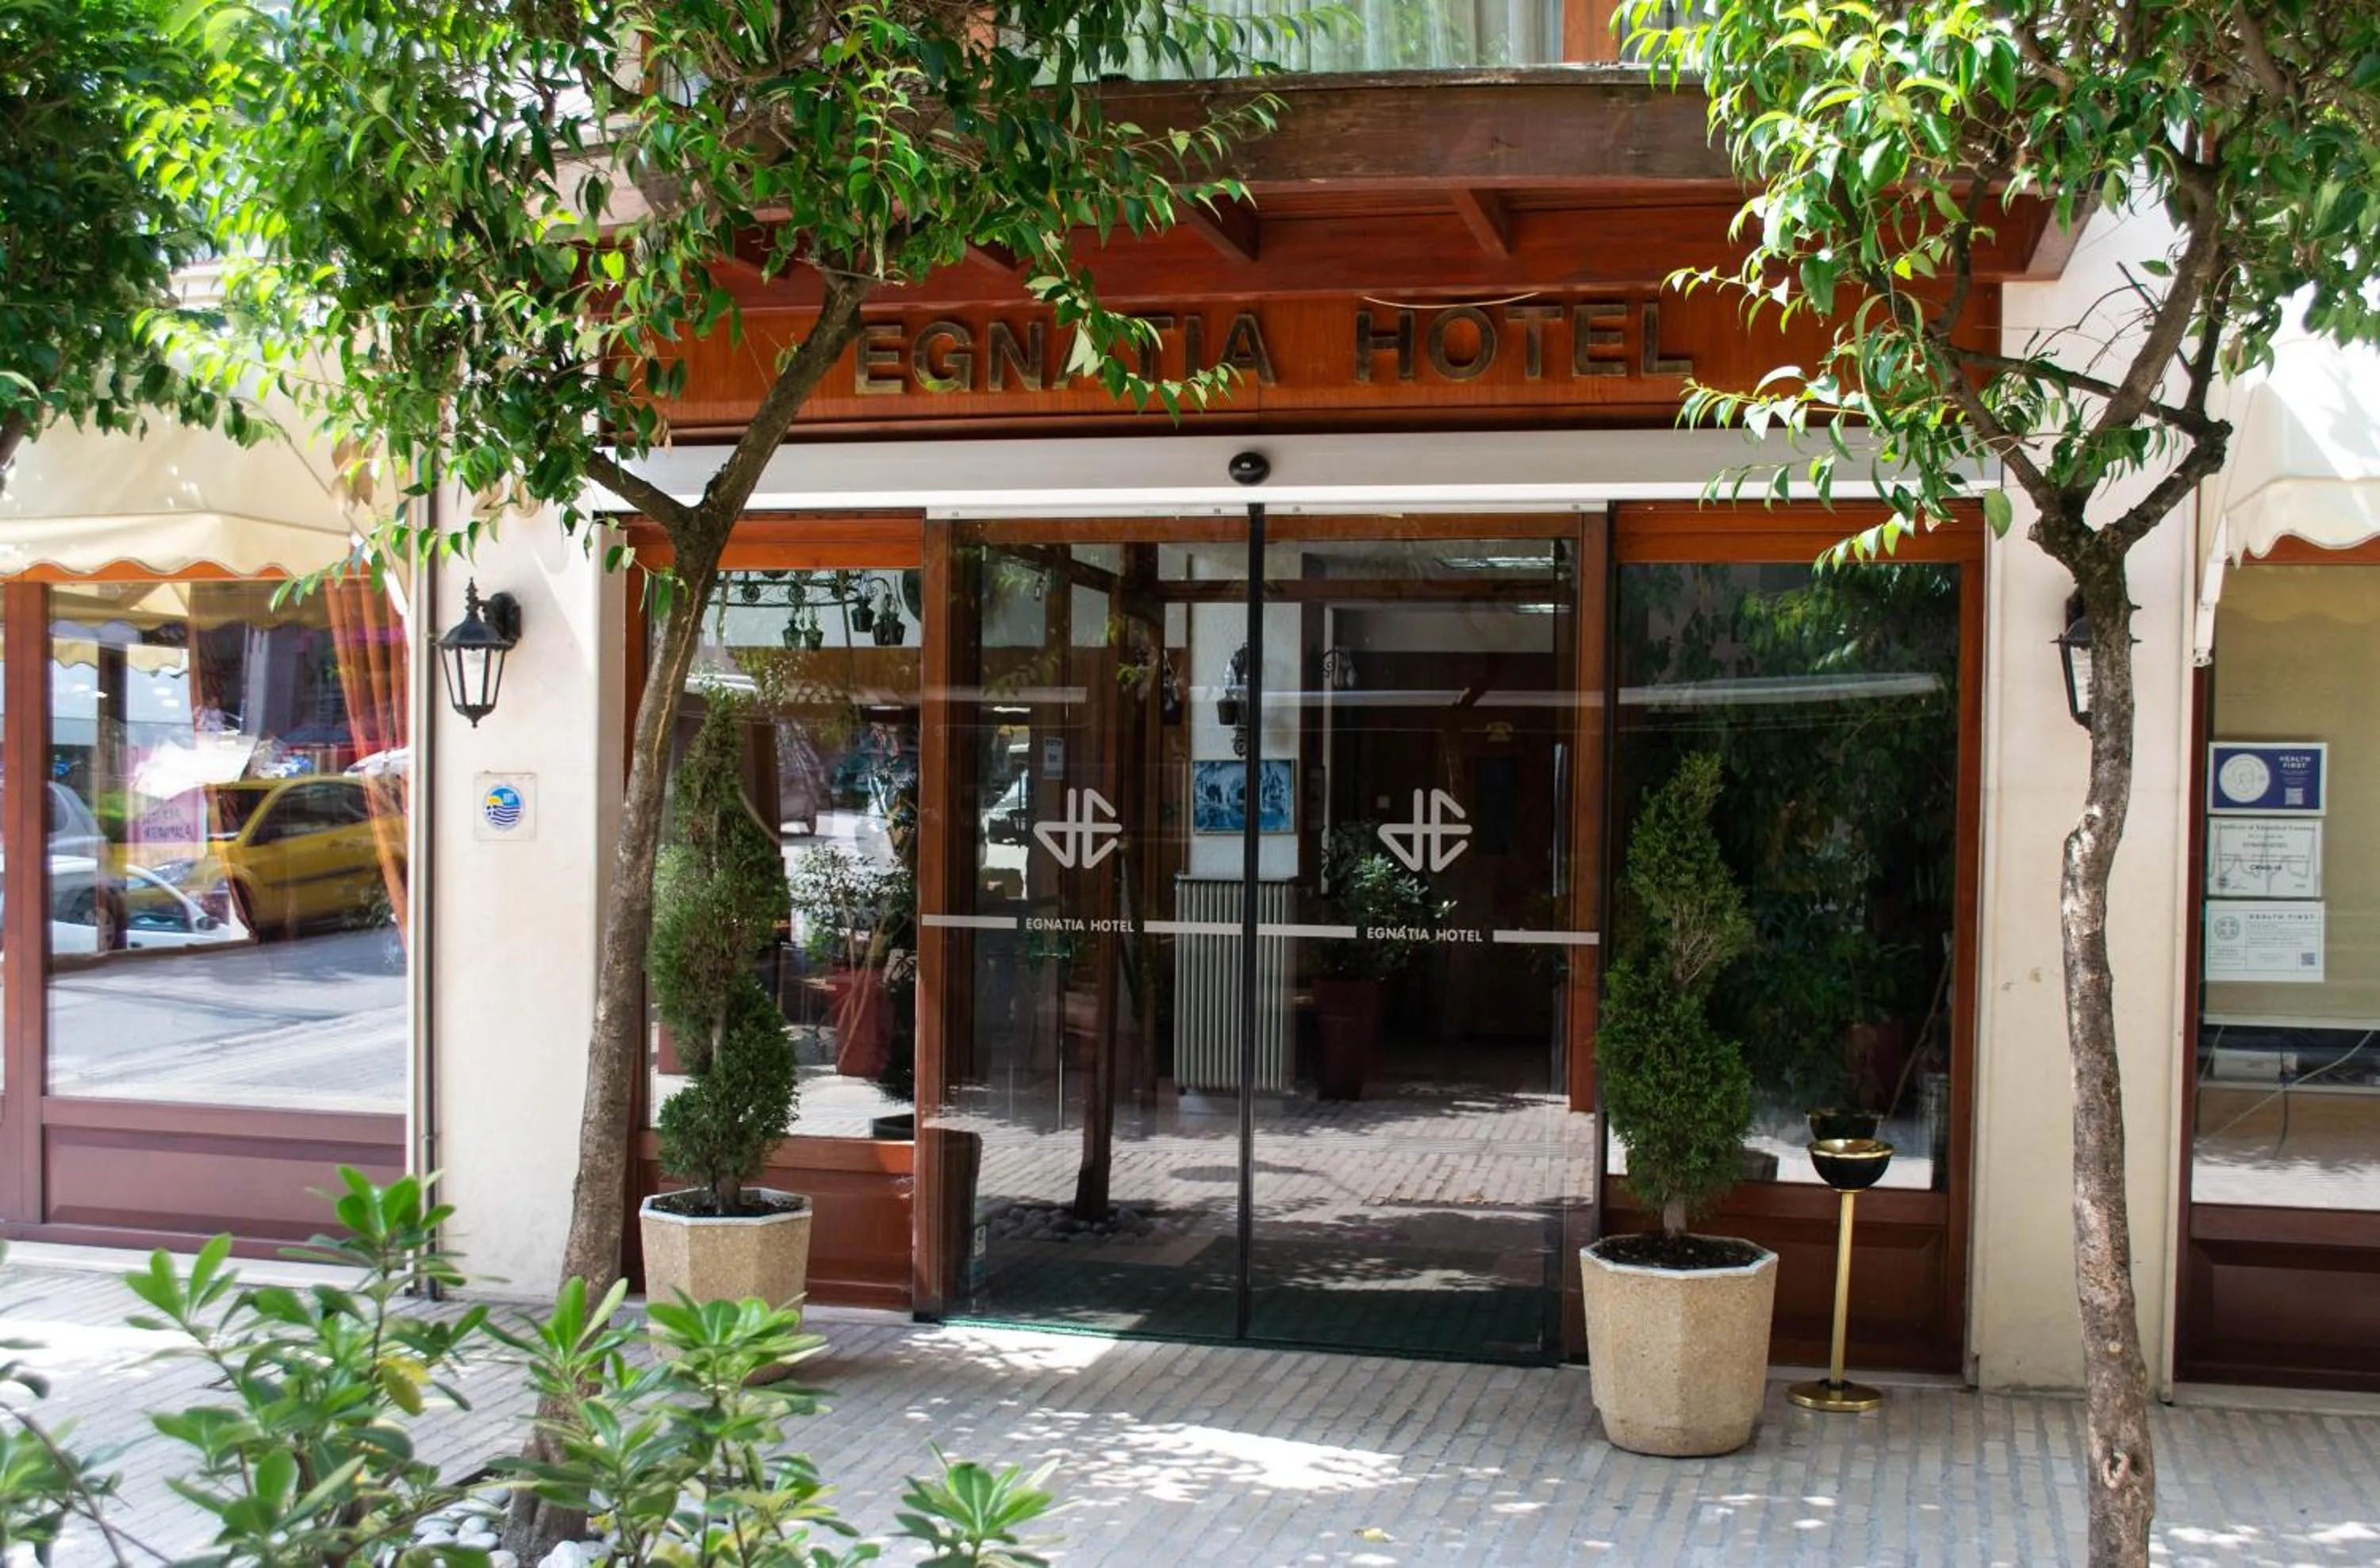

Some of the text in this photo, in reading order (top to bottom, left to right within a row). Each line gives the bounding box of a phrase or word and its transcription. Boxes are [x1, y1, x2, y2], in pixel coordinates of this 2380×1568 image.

[1356, 302, 1692, 382] HOTEL
[1025, 917, 1134, 932] EGNATIA HOTEL
[1366, 926, 1484, 942] EGNATIA HOTEL
